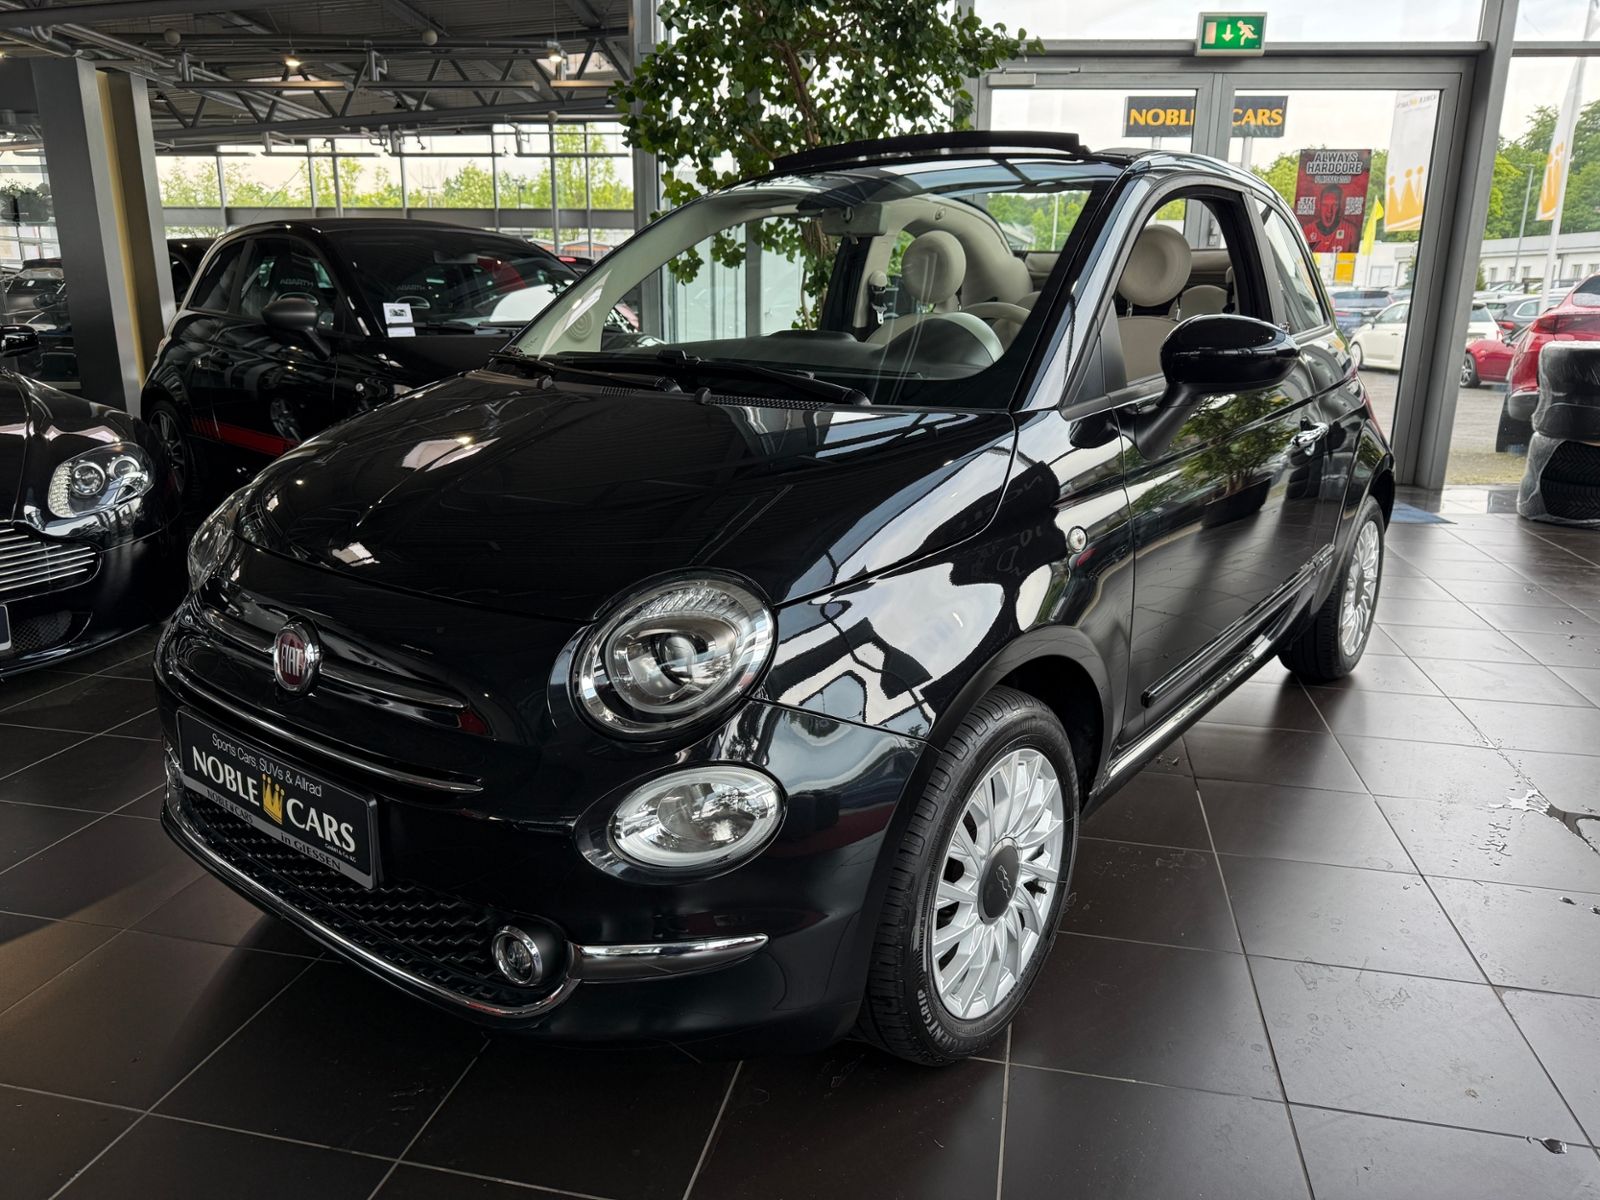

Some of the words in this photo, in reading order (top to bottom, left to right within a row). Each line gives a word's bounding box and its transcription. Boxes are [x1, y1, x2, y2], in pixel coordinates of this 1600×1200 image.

[1231, 108, 1283, 126] CARS
[1306, 162, 1363, 174] HARDCORE
[1313, 151, 1359, 163] ALWAYS
[281, 643, 303, 677] FIAT
[212, 733, 236, 758] Sports
[259, 757, 284, 781] SUVs
[285, 770, 294, 784] &
[294, 775, 322, 798] Allrad
[192, 745, 260, 807] NOBLE
[286, 798, 356, 853] CARS
[235, 807, 254, 824] CARS
[280, 832, 291, 845] in
[293, 840, 341, 871] GIESSEN
